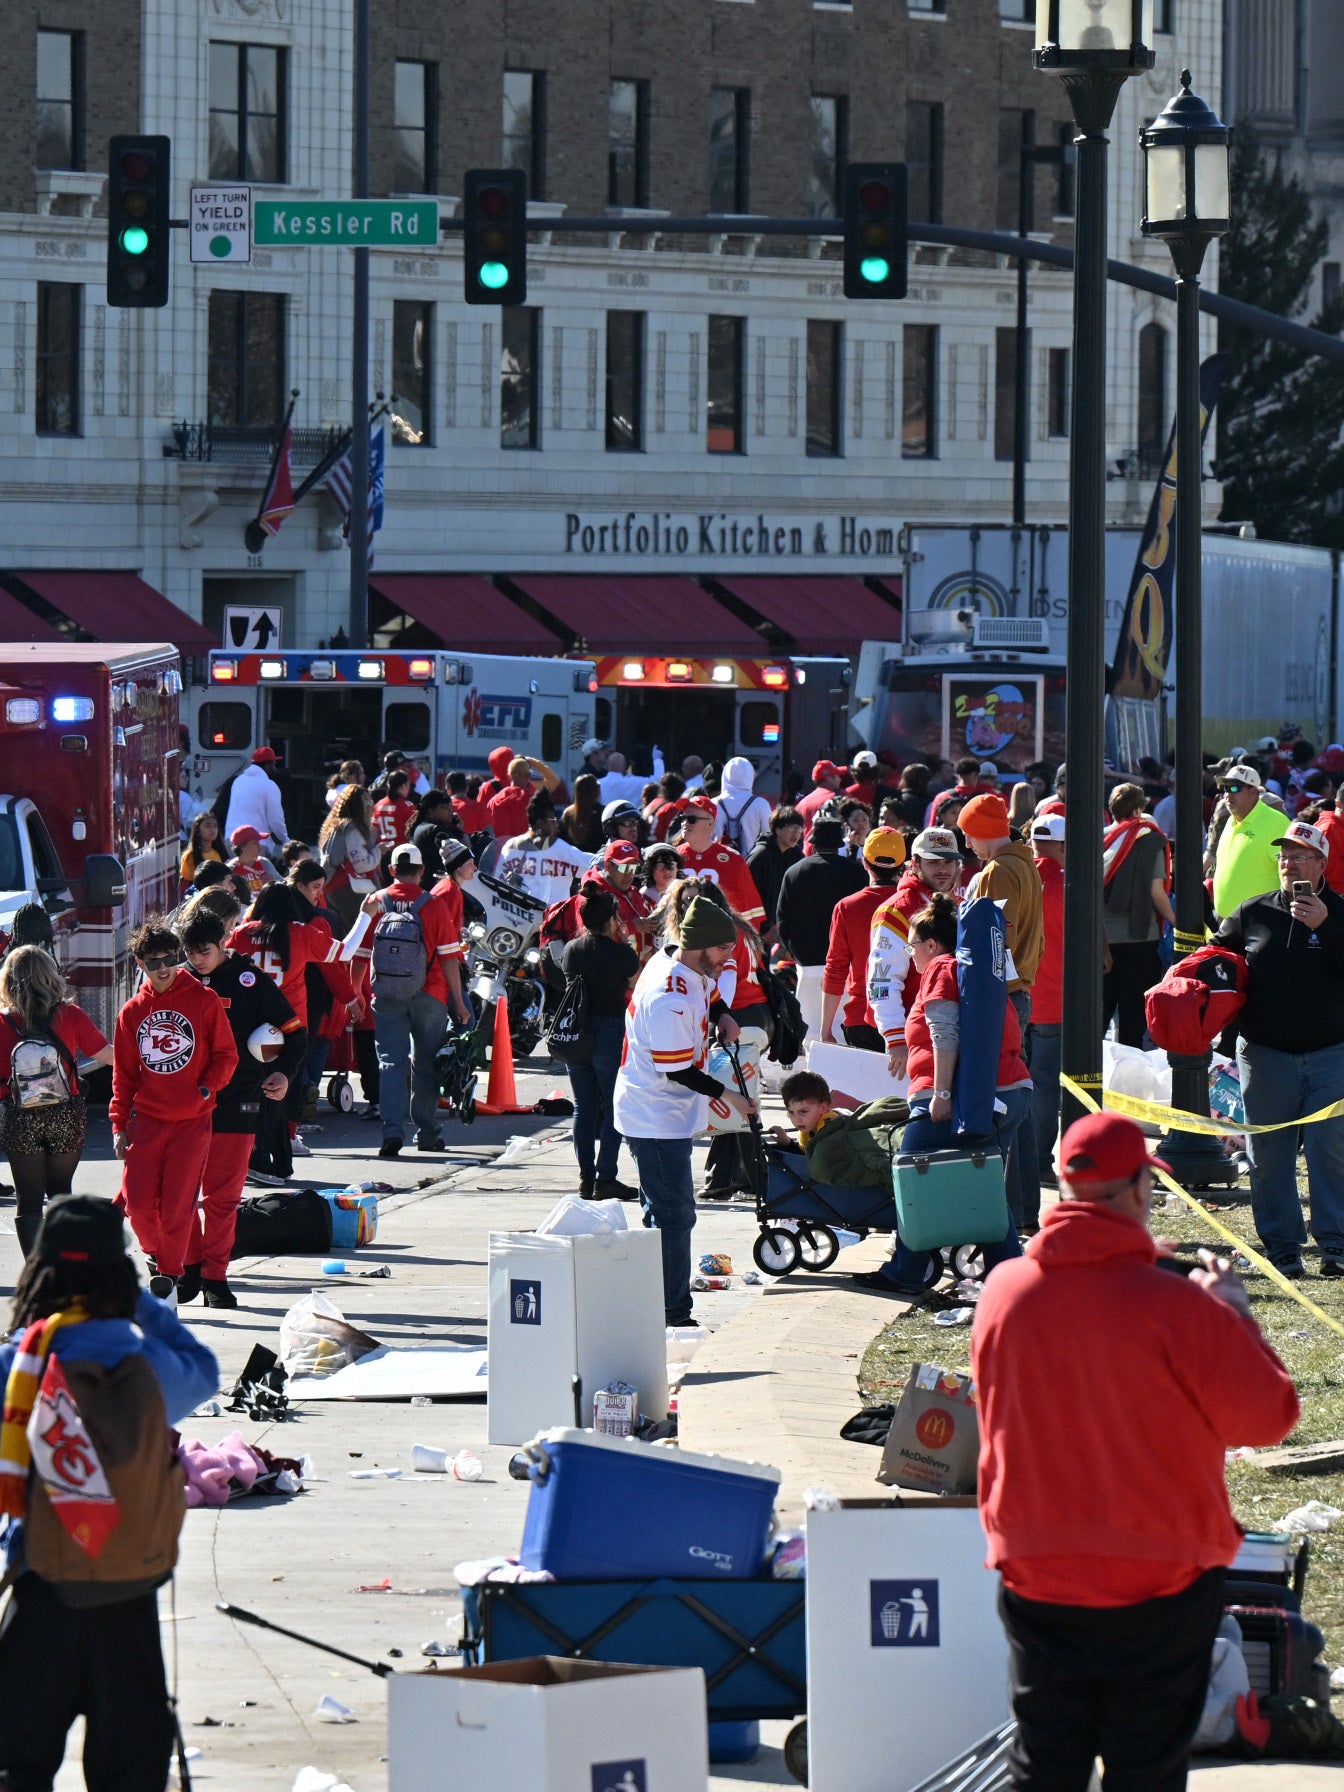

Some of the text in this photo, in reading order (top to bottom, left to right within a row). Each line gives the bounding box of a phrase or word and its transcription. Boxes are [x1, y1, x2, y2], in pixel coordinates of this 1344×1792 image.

[194, 192, 248, 204] LEFT TURN
[198, 206, 243, 219] YIELD
[273, 210, 419, 235] Kessler Rd
[195, 221, 246, 232] ON GREEN
[565, 512, 689, 554] Portfolio
[698, 512, 803, 555] Kitchen
[813, 521, 828, 554] &
[378, 815, 398, 839] 15
[491, 895, 535, 924] POLICE
[664, 974, 688, 996] 15
[154, 1055, 190, 1073] CHIEFS
[899, 1447, 952, 1473] McDelivery
